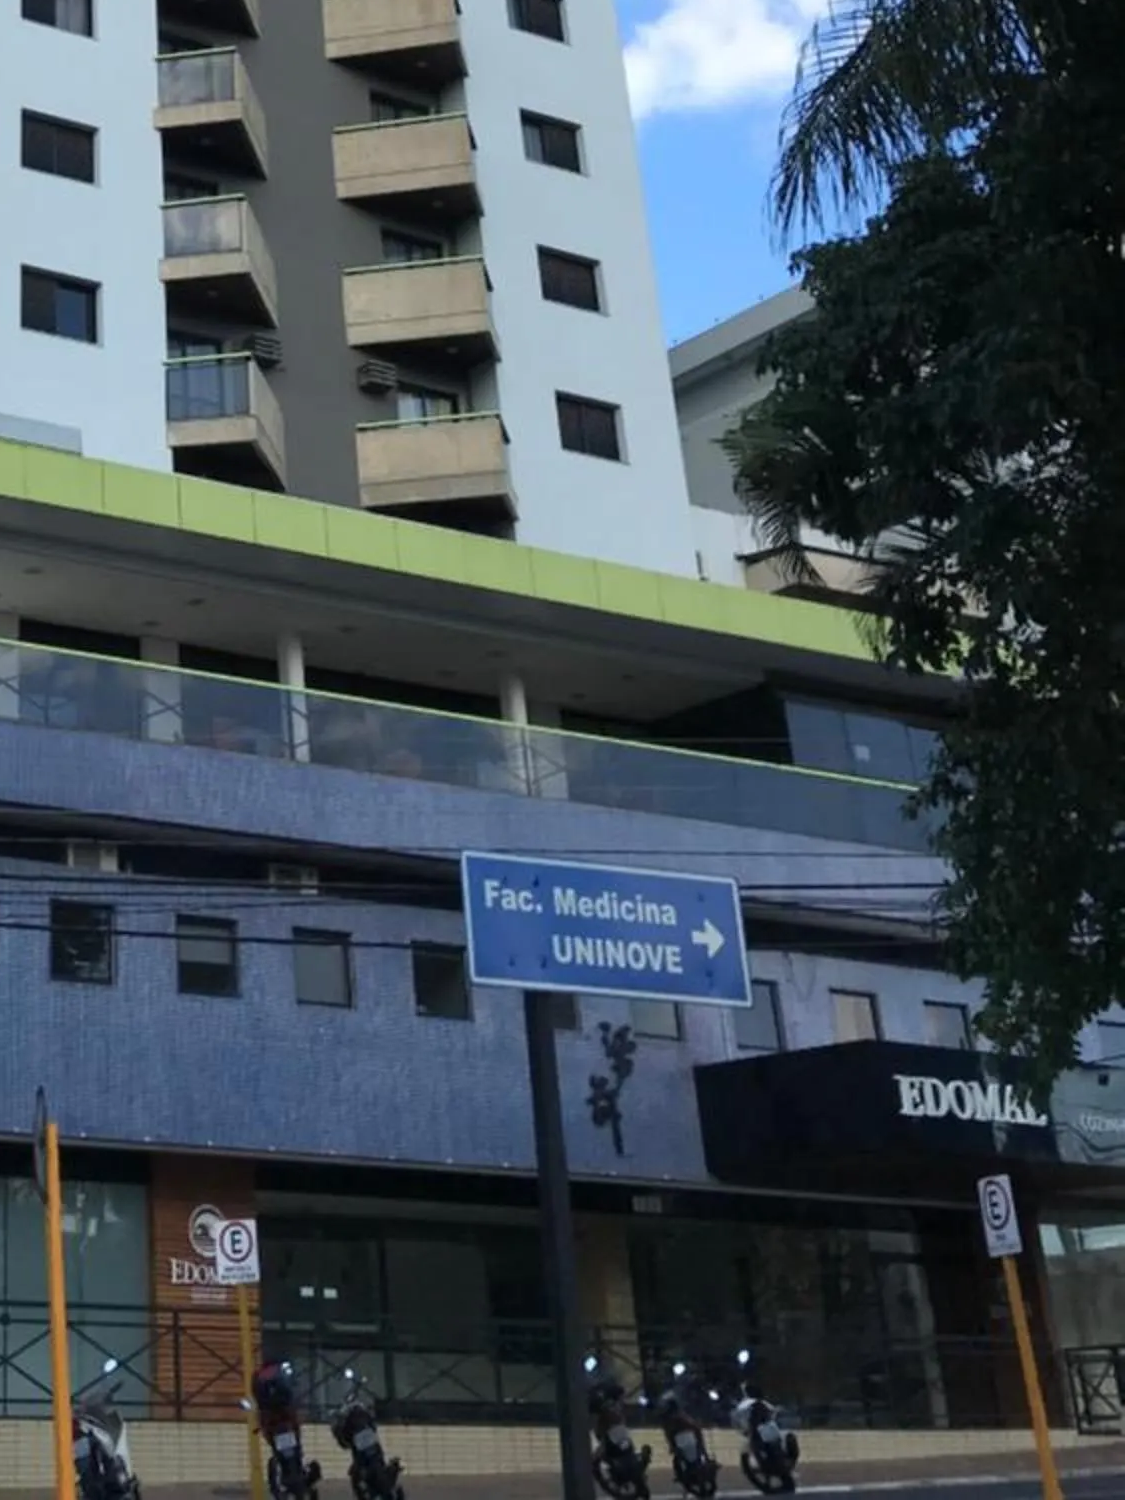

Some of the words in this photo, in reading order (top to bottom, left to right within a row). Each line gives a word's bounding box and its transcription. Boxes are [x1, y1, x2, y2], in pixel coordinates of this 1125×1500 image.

[483, 879, 543, 914] Fac.
[552, 886, 677, 926] Medicina
[552, 935, 683, 974] UNINOVE
[230, 1229, 243, 1255] E
